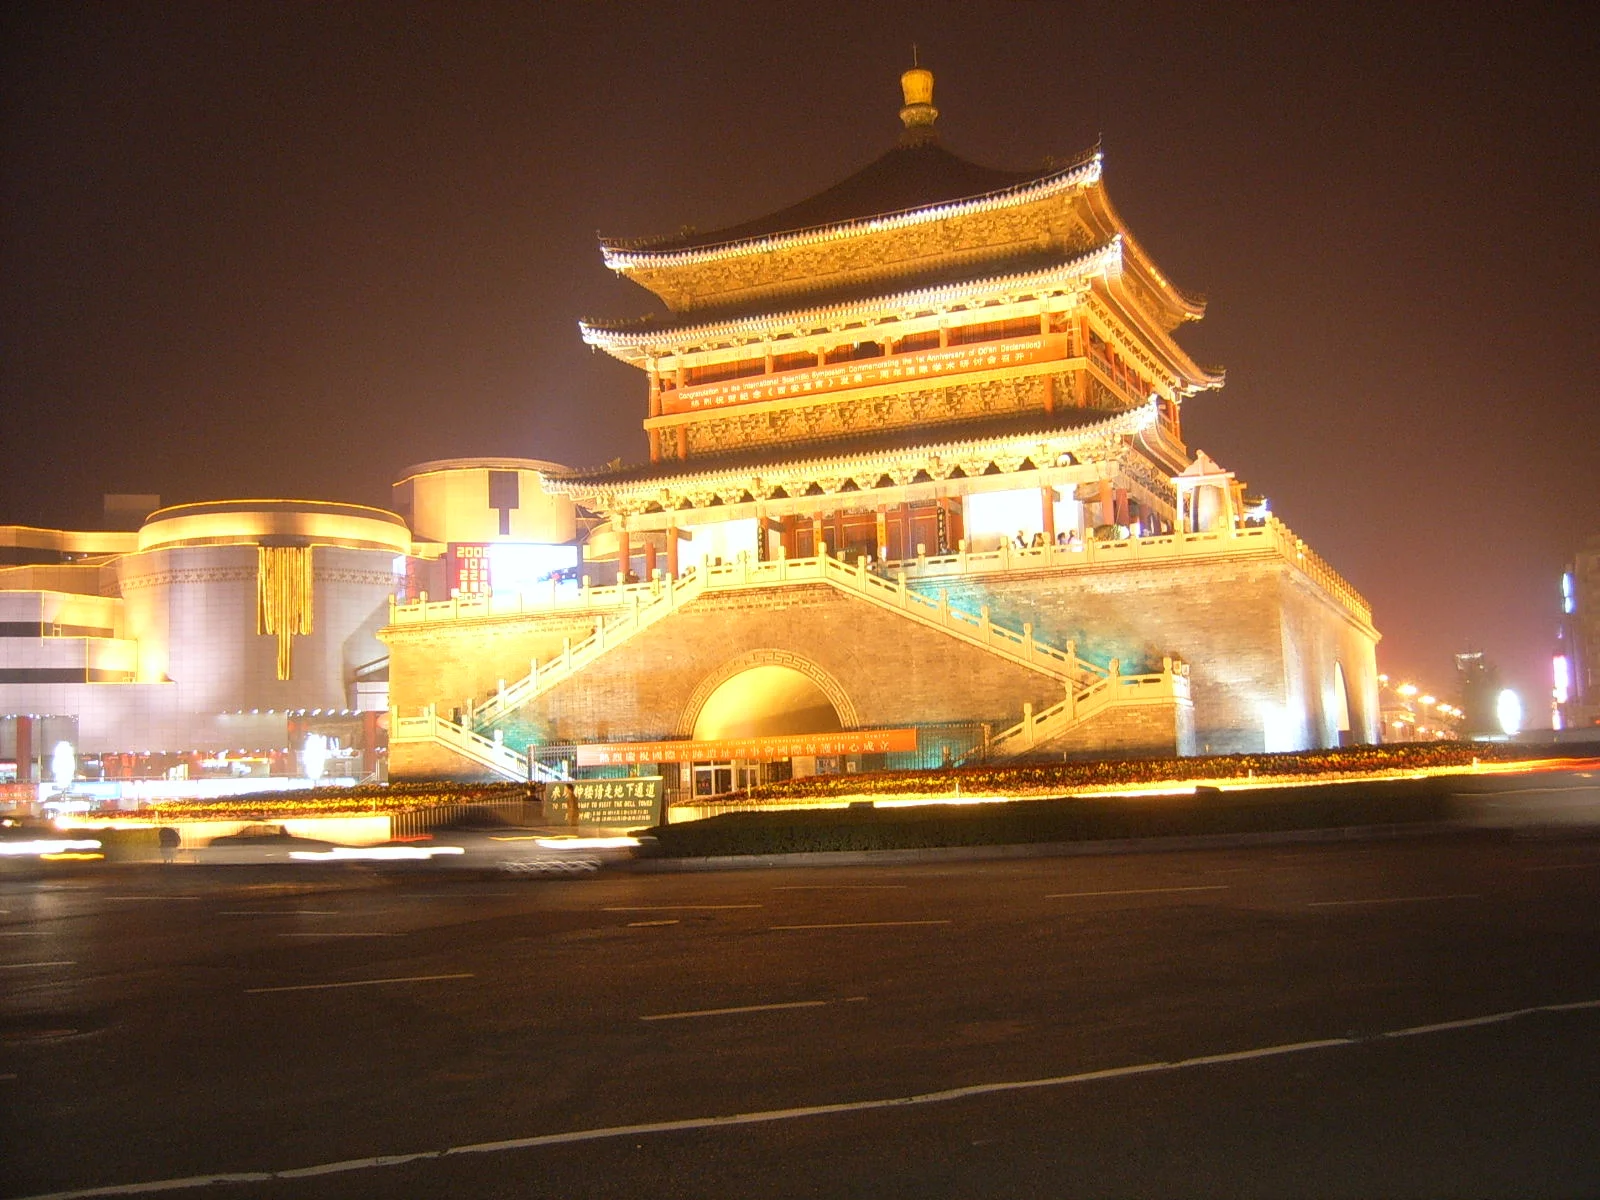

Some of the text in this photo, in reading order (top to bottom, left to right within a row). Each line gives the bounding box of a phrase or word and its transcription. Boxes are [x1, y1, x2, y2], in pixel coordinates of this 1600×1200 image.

[731, 384, 741, 392] the
[742, 377, 779, 390] International
[812, 368, 846, 379] Symposium
[848, 359, 899, 373] Commemorating
[902, 357, 912, 366] the
[927, 350, 965, 362] Anniversary
